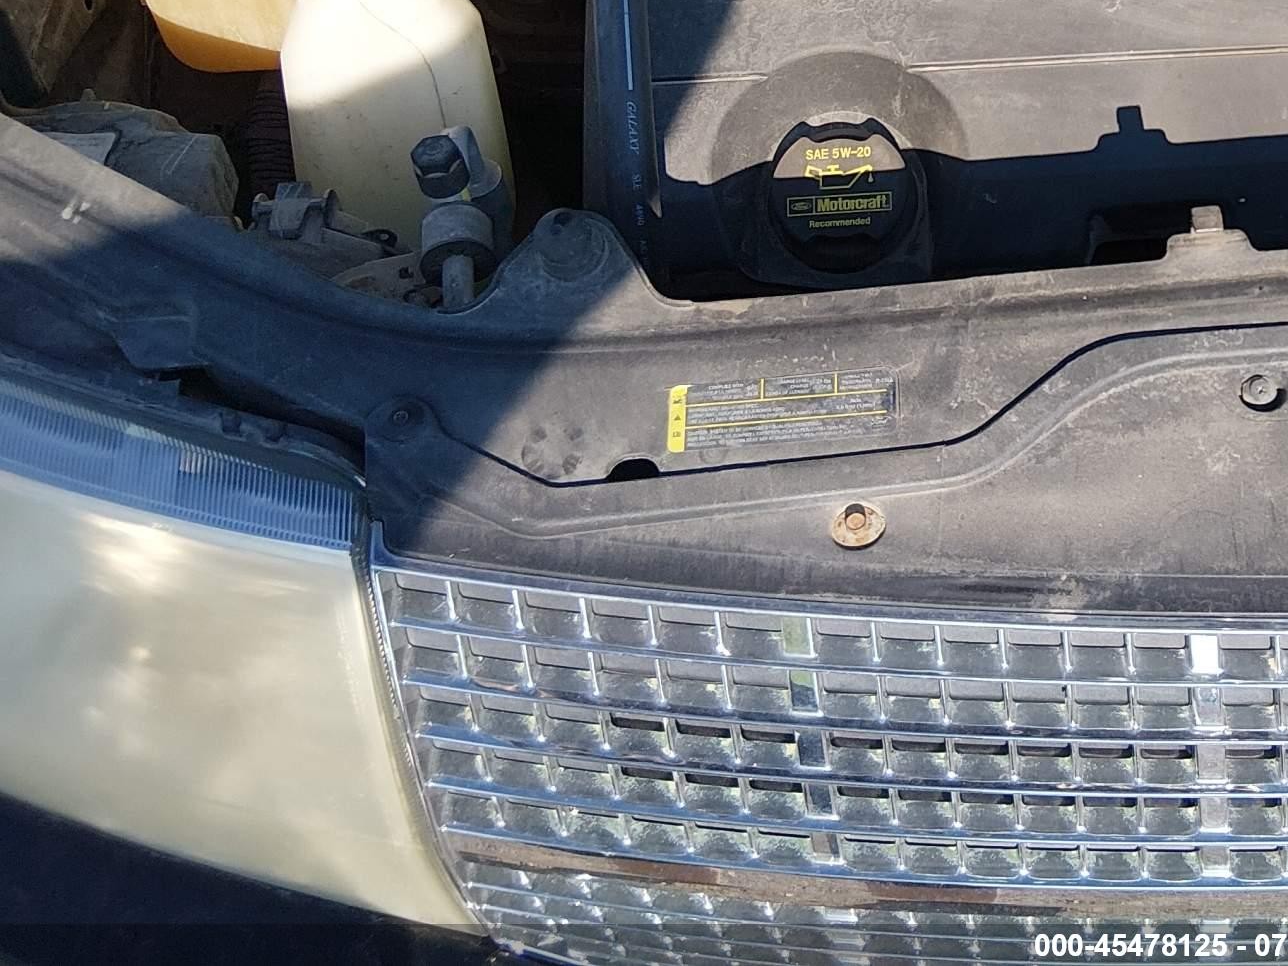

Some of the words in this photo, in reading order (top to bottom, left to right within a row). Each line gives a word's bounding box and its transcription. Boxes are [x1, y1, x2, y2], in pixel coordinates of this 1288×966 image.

[627, 101, 640, 155] GALAXY
[805, 149, 829, 160] SAE
[832, 146, 871, 159] 5W-20
[816, 194, 888, 212] Motorcraft
[809, 217, 871, 228] Recommended
